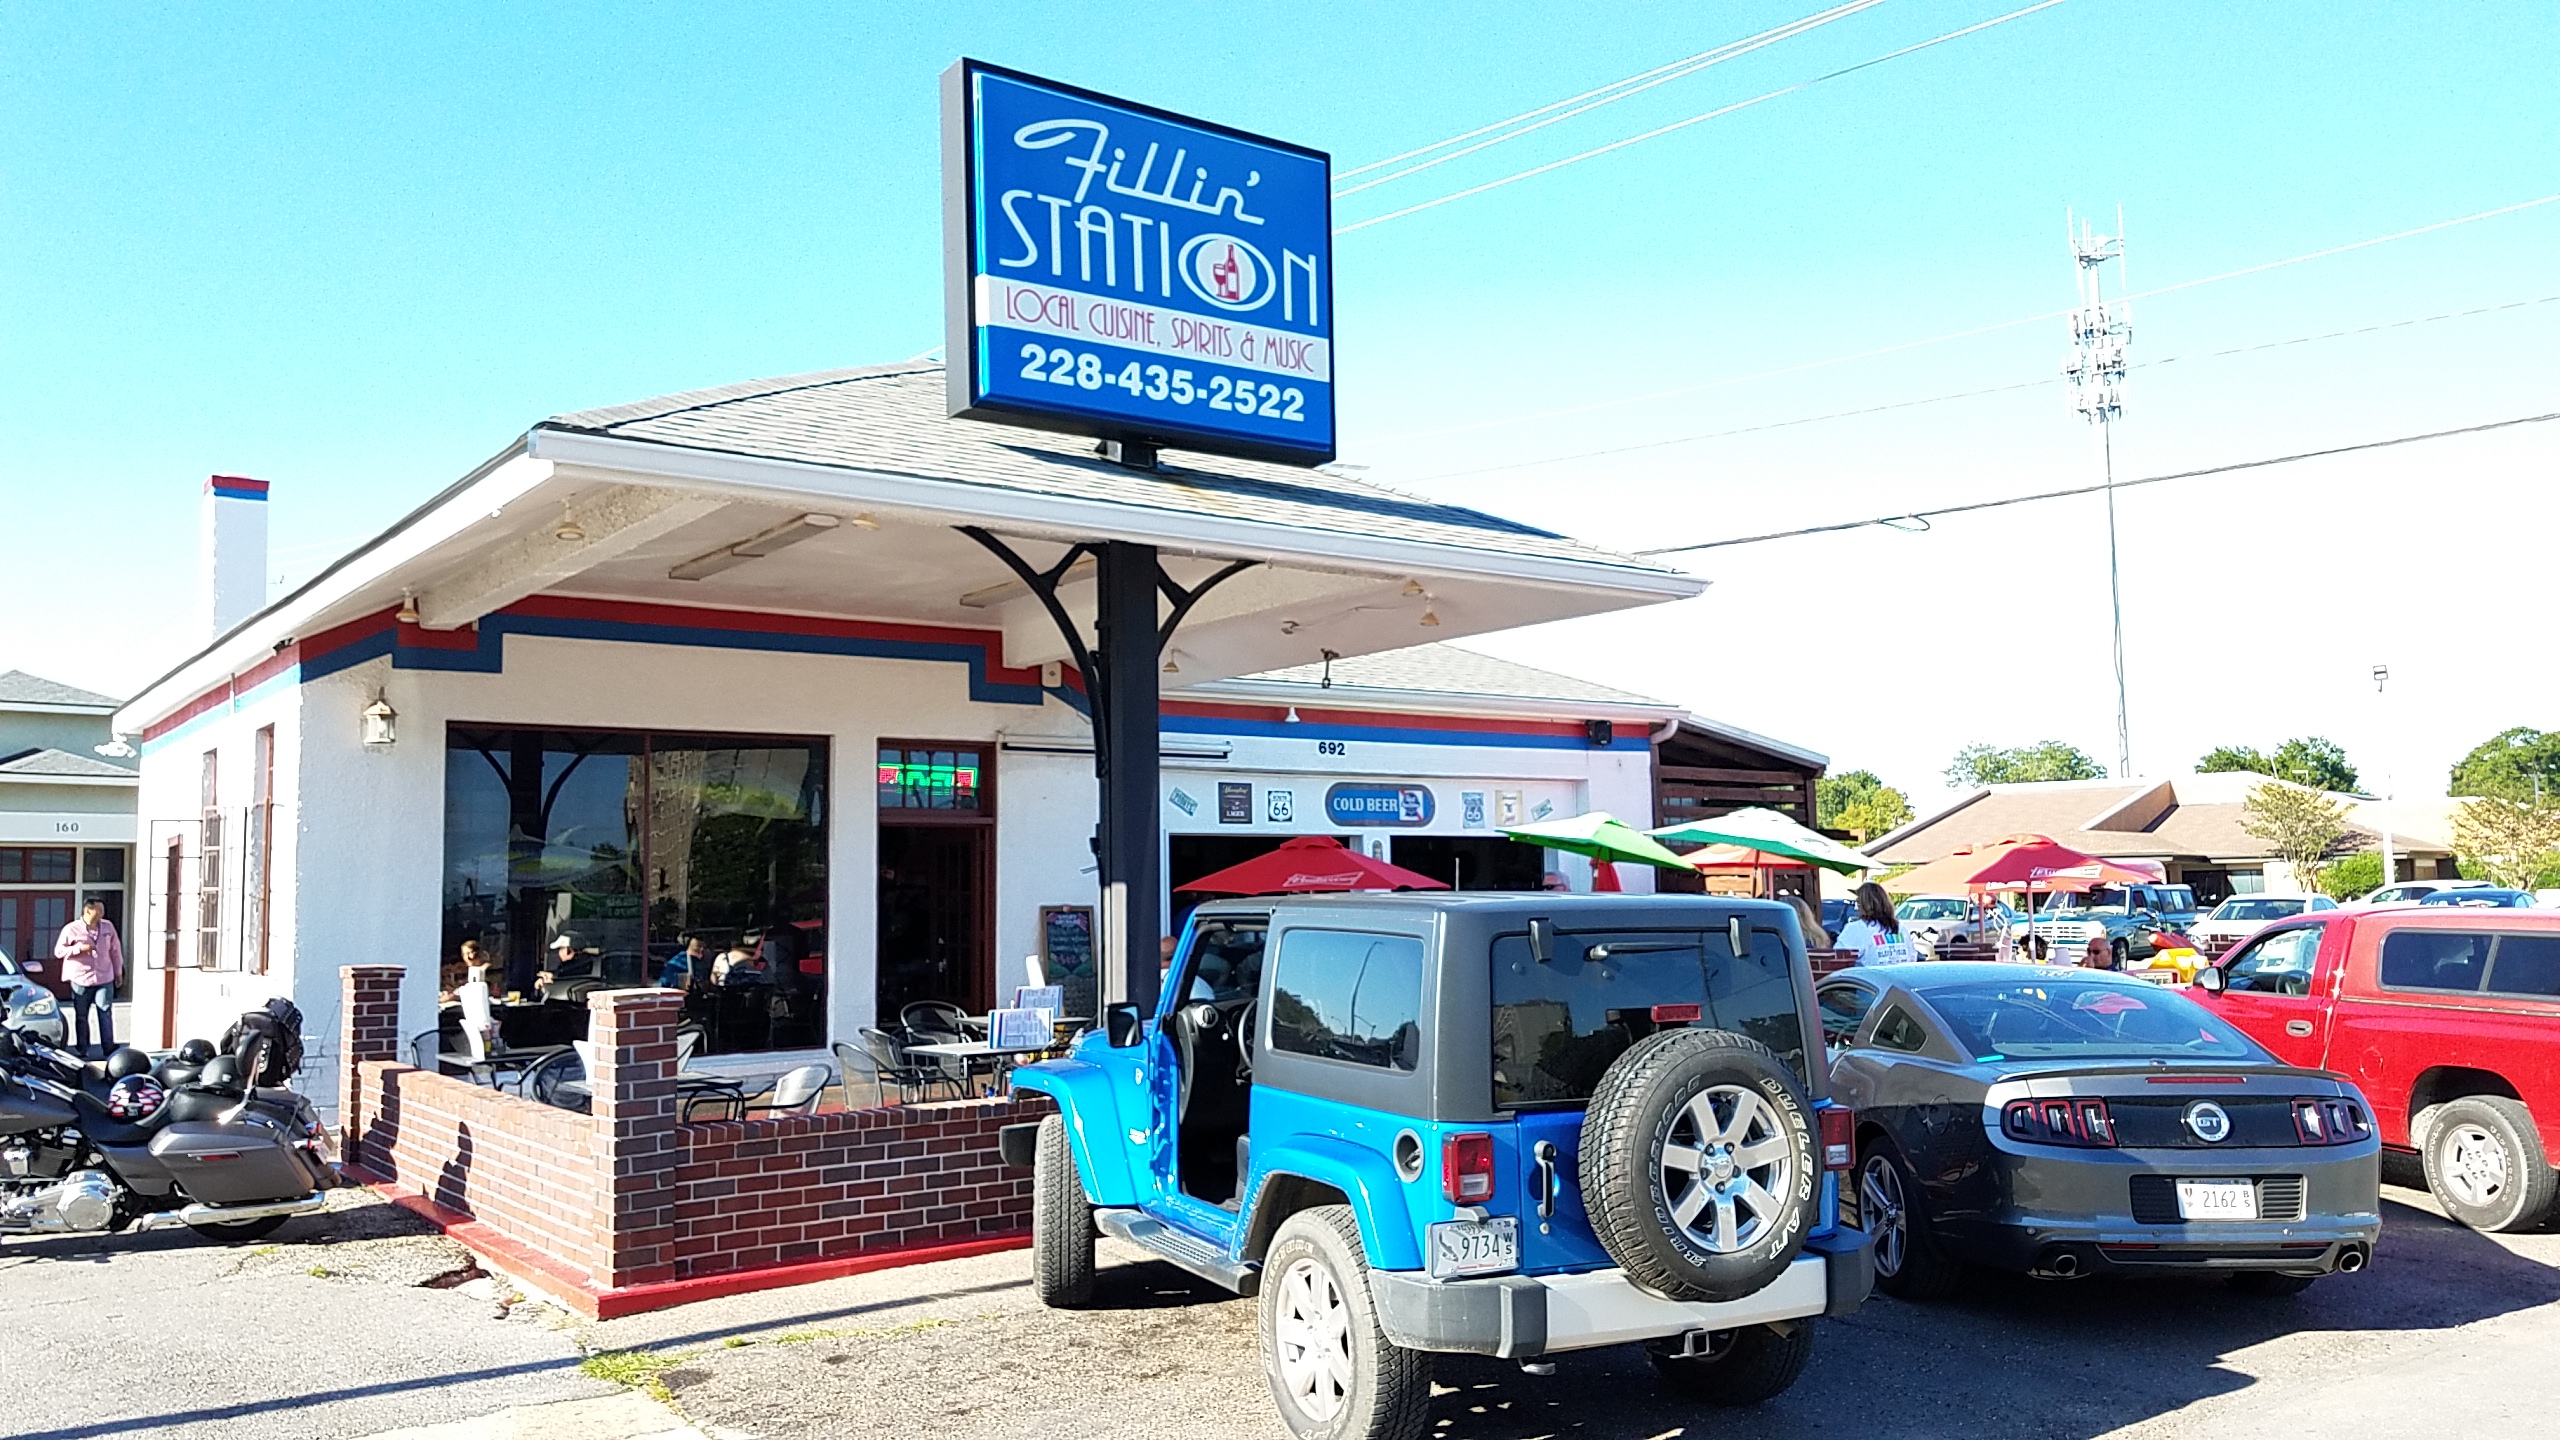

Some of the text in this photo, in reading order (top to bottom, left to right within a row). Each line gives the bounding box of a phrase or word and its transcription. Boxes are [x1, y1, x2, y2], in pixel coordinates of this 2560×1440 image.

[1014, 119, 1265, 225] Fillin'
[999, 190, 1318, 327] STATION
[1006, 285, 1314, 373] LOCAL CUISINE, SPIRITS & MUSIC
[1020, 342, 1305, 422] 228-435-2522
[1318, 741, 1346, 756] 692
[1273, 802, 1289, 816] 66
[1333, 797, 1364, 811] COLD
[1366, 798, 1398, 812] BEER
[56, 822, 79, 832] 160
[2196, 1116, 2220, 1128] GT
[1760, 1077, 1814, 1201] DUELER
[2202, 1190, 2238, 1208] 2162
[1461, 1233, 1500, 1260] 9734
